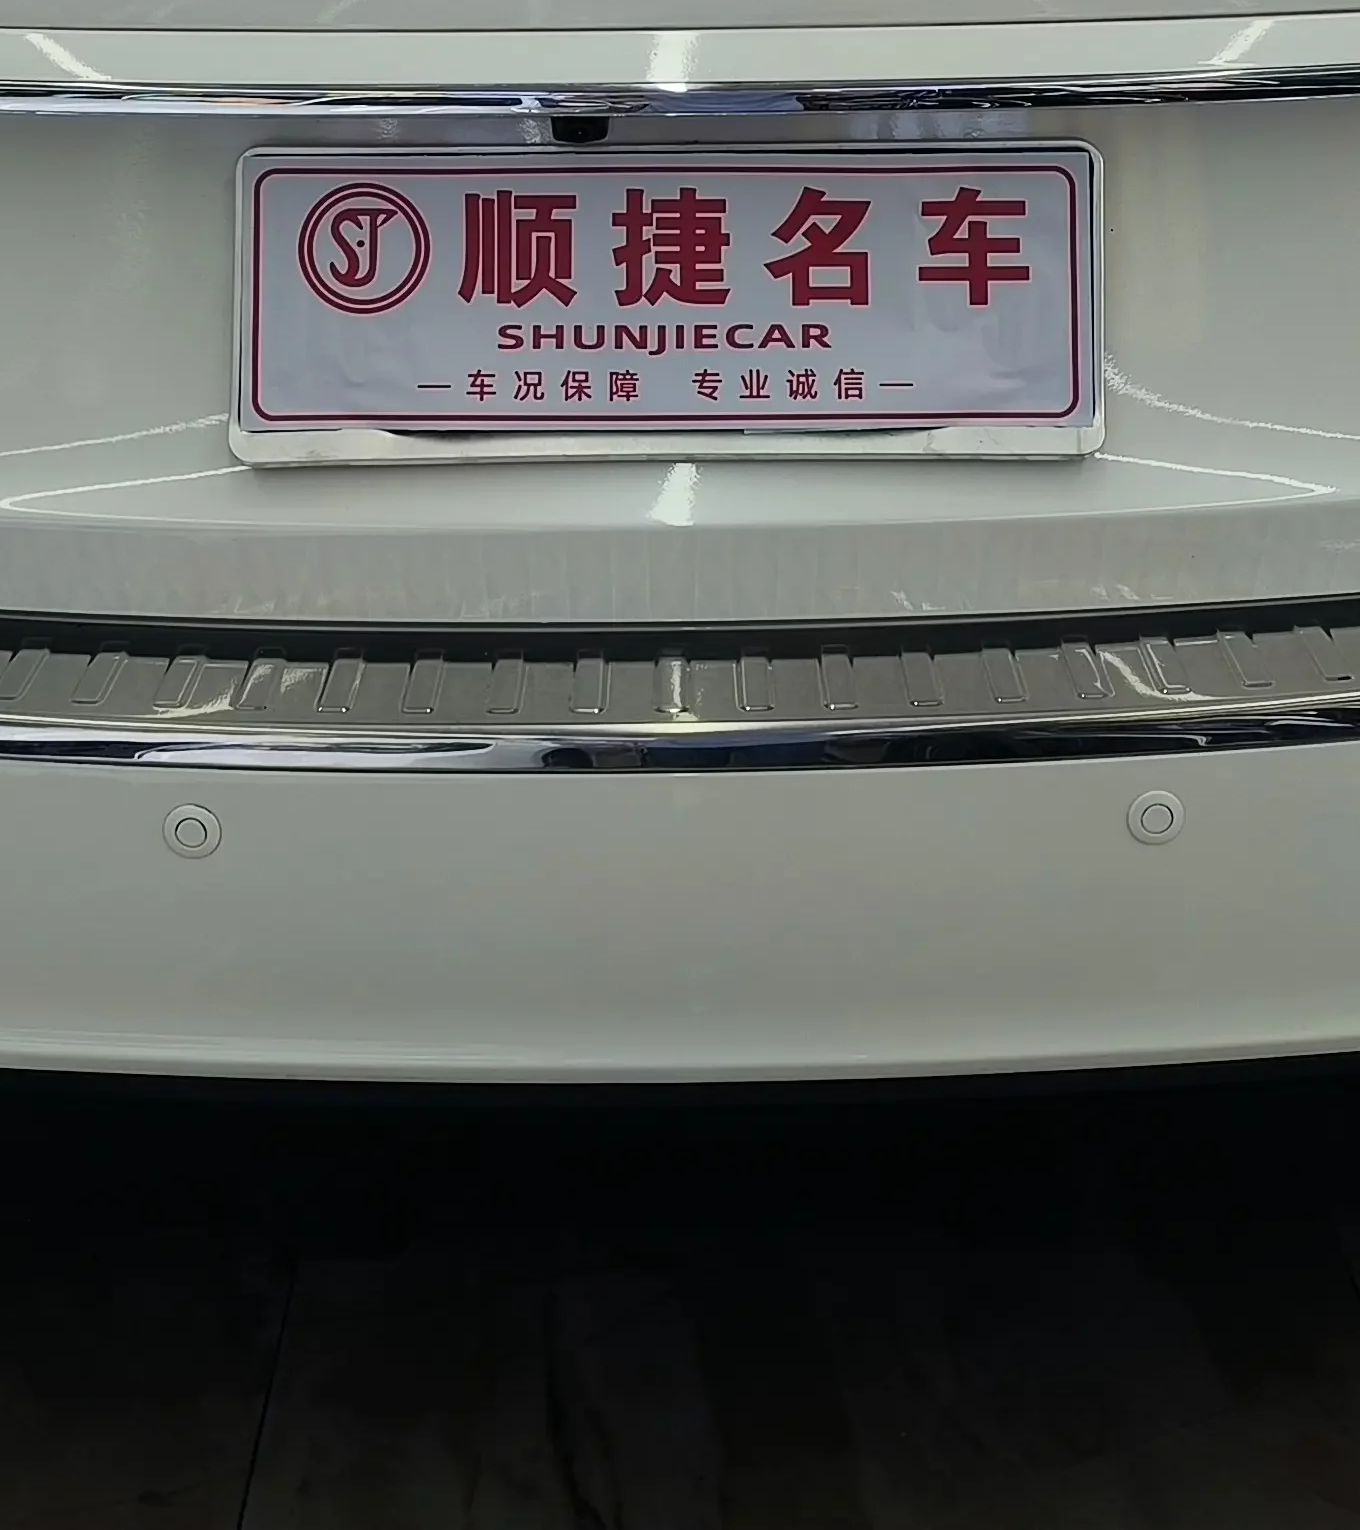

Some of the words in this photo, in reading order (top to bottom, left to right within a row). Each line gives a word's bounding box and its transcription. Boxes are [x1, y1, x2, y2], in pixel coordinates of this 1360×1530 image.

[457, 186, 1031, 307] 顺捷名车
[495, 321, 834, 356] SHUNJIECAR
[466, 368, 642, 403] 车况保障
[691, 368, 867, 403] 专业诚信
